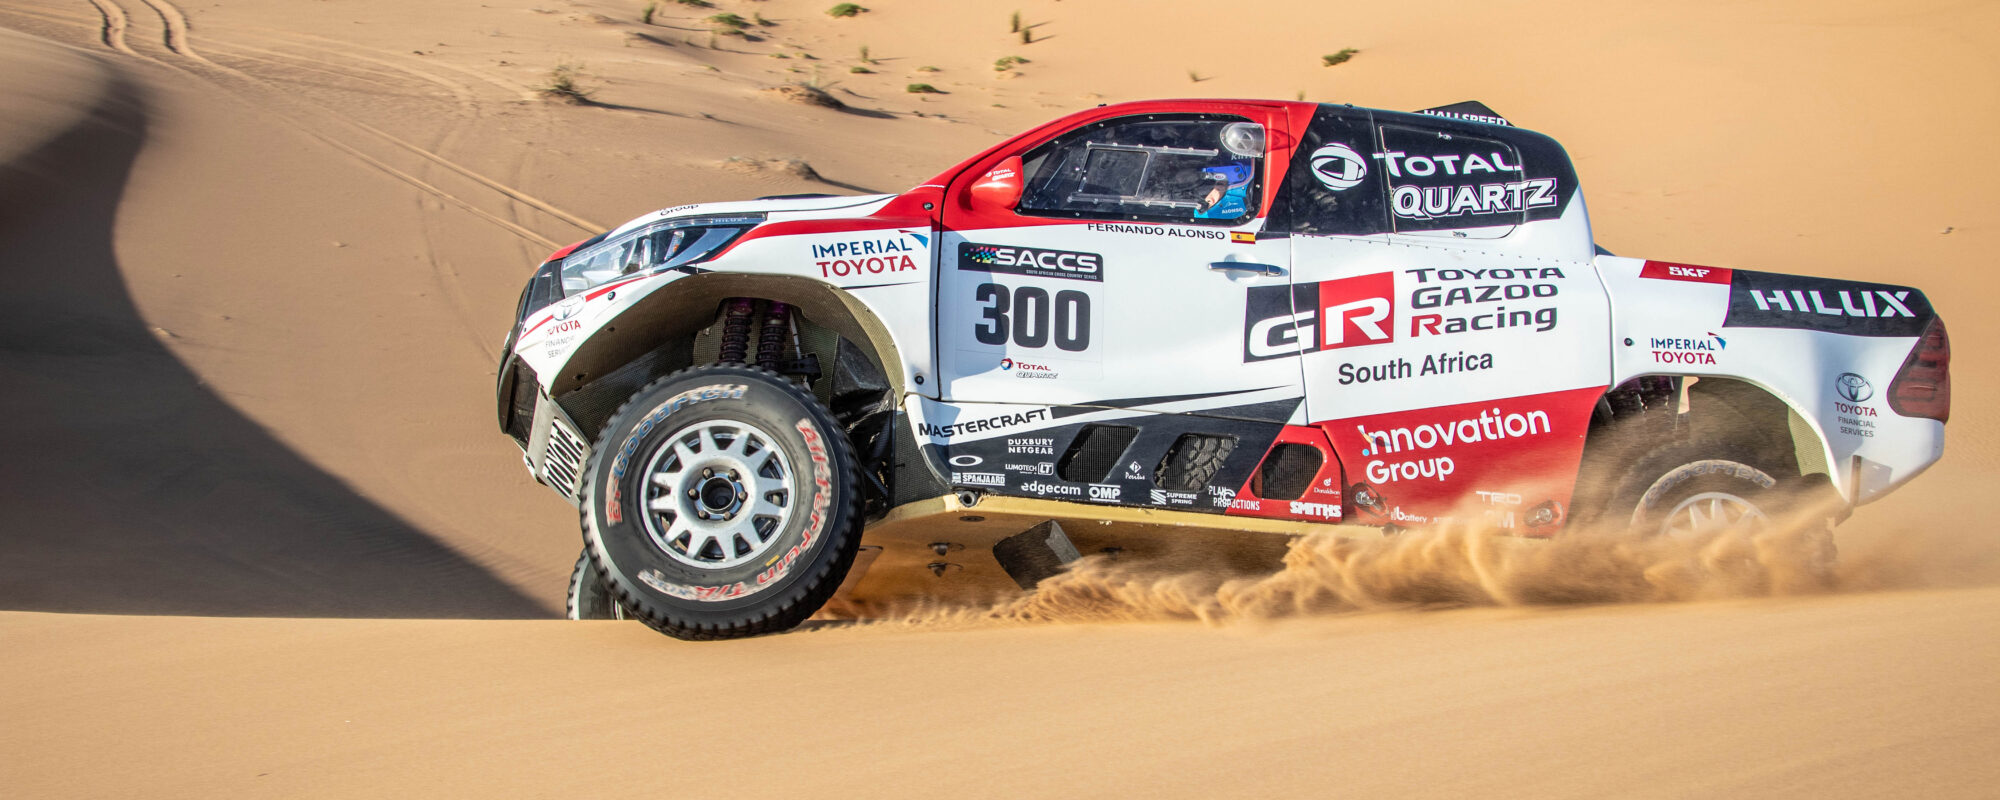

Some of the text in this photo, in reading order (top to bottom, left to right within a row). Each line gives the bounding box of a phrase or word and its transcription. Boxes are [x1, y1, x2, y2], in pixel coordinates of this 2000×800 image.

[1372, 150, 1522, 177] TOTAL
[1390, 177, 1558, 220] QUARTZ
[1087, 222, 1226, 240] FERNANDO ALONSO
[812, 238, 912, 259] IMPERIAL
[816, 254, 917, 278] TOYOTA
[995, 248, 1098, 273] SACCS
[1405, 266, 1566, 283] TOYOTA
[1668, 266, 1710, 278] SKF
[1410, 284, 1558, 310] GAZOO
[1750, 289, 1916, 318] HILUX
[975, 283, 1091, 352] 300
[1410, 307, 1558, 338] Racing
[1249, 296, 1391, 358] GR
[1650, 337, 1715, 351] IMPERIAL
[1016, 361, 1051, 371] TOTAL
[1652, 350, 1716, 365] TOYOTA
[1338, 351, 1494, 385] South Africa
[1834, 402, 1878, 417] TOYOTA
[918, 408, 1047, 438] MASTERCRAFT
[1838, 416, 1876, 429] FINANCIAL
[1840, 426, 1874, 438] SERVICES
[1007, 438, 1054, 446] DUXBURY
[1008, 446, 1054, 455] NETGEAR
[542, 417, 584, 498] TOYOTA
[1005, 463, 1052, 474] LUMOTECH LT
[1366, 456, 1455, 484] Group
[962, 474, 1006, 484] SPANJAARD
[1020, 480, 1081, 495] edgecam
[1088, 486, 1121, 499] OMP
[1166, 492, 1197, 500] SUPREME
[1313, 487, 1340, 495] Donaldson
[1289, 501, 1342, 518] SMITHS
